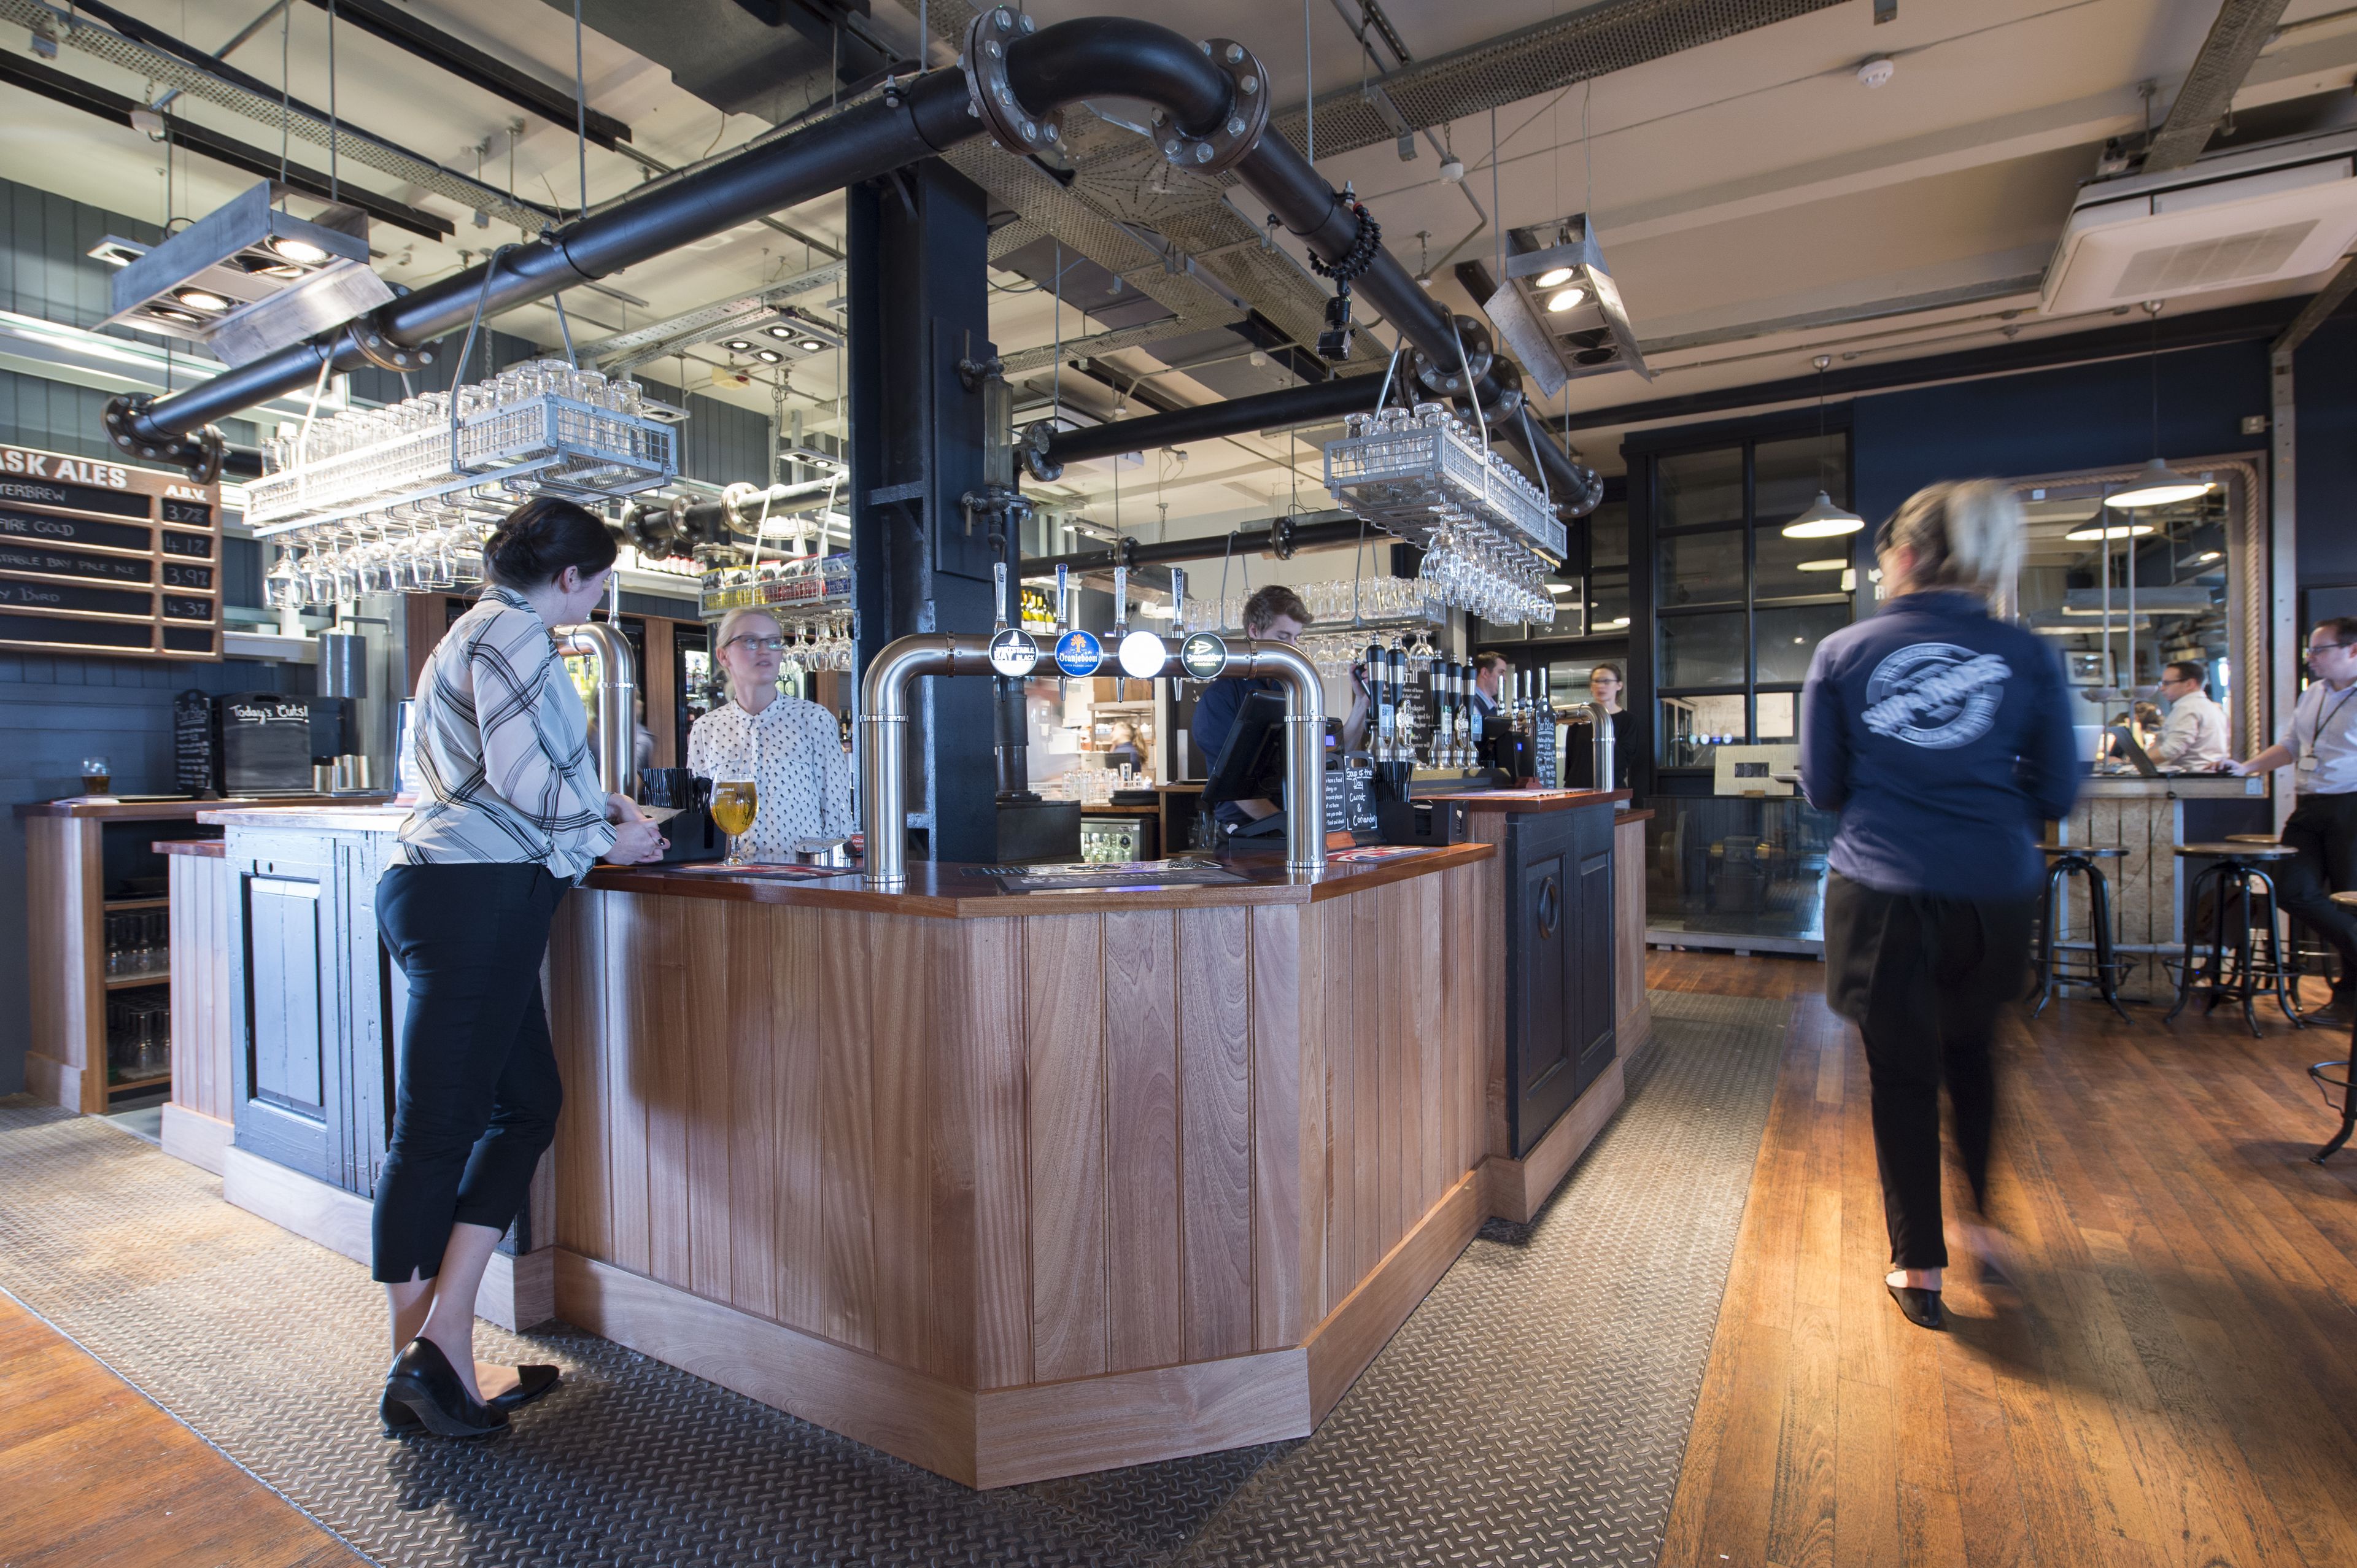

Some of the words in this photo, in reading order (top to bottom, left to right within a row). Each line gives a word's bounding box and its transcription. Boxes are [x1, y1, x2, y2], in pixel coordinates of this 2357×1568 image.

[0, 450, 47, 476] SK
[54, 460, 128, 489] ALES
[34, 521, 75, 536] GOLD
[46, 557, 72, 568] BAY
[77, 560, 109, 572] PALE
[994, 650, 1013, 661] BAY
[1059, 653, 1098, 664] Oranjeboom
[1403, 670, 1418, 686] rill
[228, 705, 273, 725] Today's
[1346, 768, 1358, 779] Soup
[1358, 768, 1364, 778] of
[1352, 778, 1363, 790] Day
[1349, 793, 1366, 802] Carrot
[1357, 803, 1362, 813] &
[1353, 813, 1376, 827] Coriander
